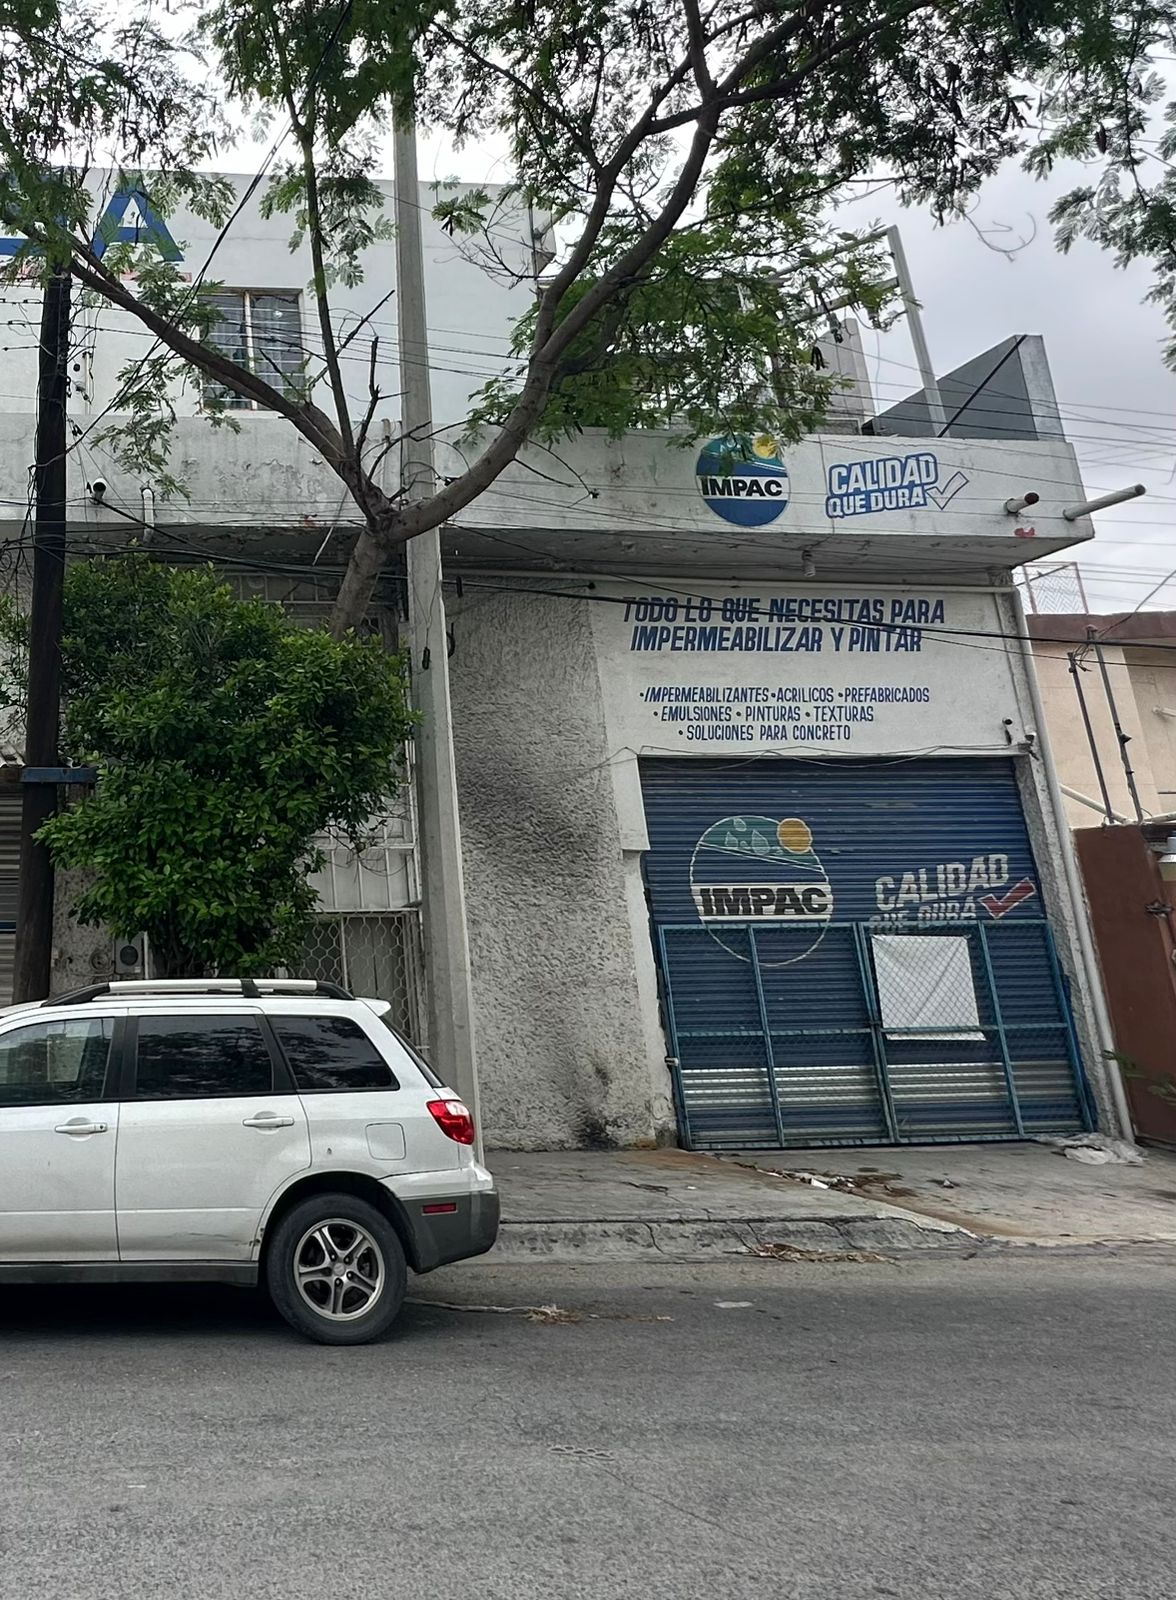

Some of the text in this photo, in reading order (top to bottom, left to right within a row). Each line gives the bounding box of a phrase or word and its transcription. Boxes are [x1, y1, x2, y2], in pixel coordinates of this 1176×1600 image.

[702, 477, 783, 497] IMPAC
[830, 453, 937, 495] CALIDAD
[829, 486, 924, 518] QUE DURA
[623, 597, 945, 624] TODO LO QUE NECESITAS PARA
[630, 626, 922, 652] IMPERMEABILIZAR Y PINTAR
[644, 686, 930, 703] IMPERMEABILIZANTES ACRILICOS PREFABRICADOS
[660, 706, 874, 722] EMULSIONES PINTURAS TEXTURAS
[686, 725, 851, 741] SOLUCIONES PARA CONCRETO
[875, 854, 1010, 911] CALIDAD
[700, 887, 830, 916] IMPAC
